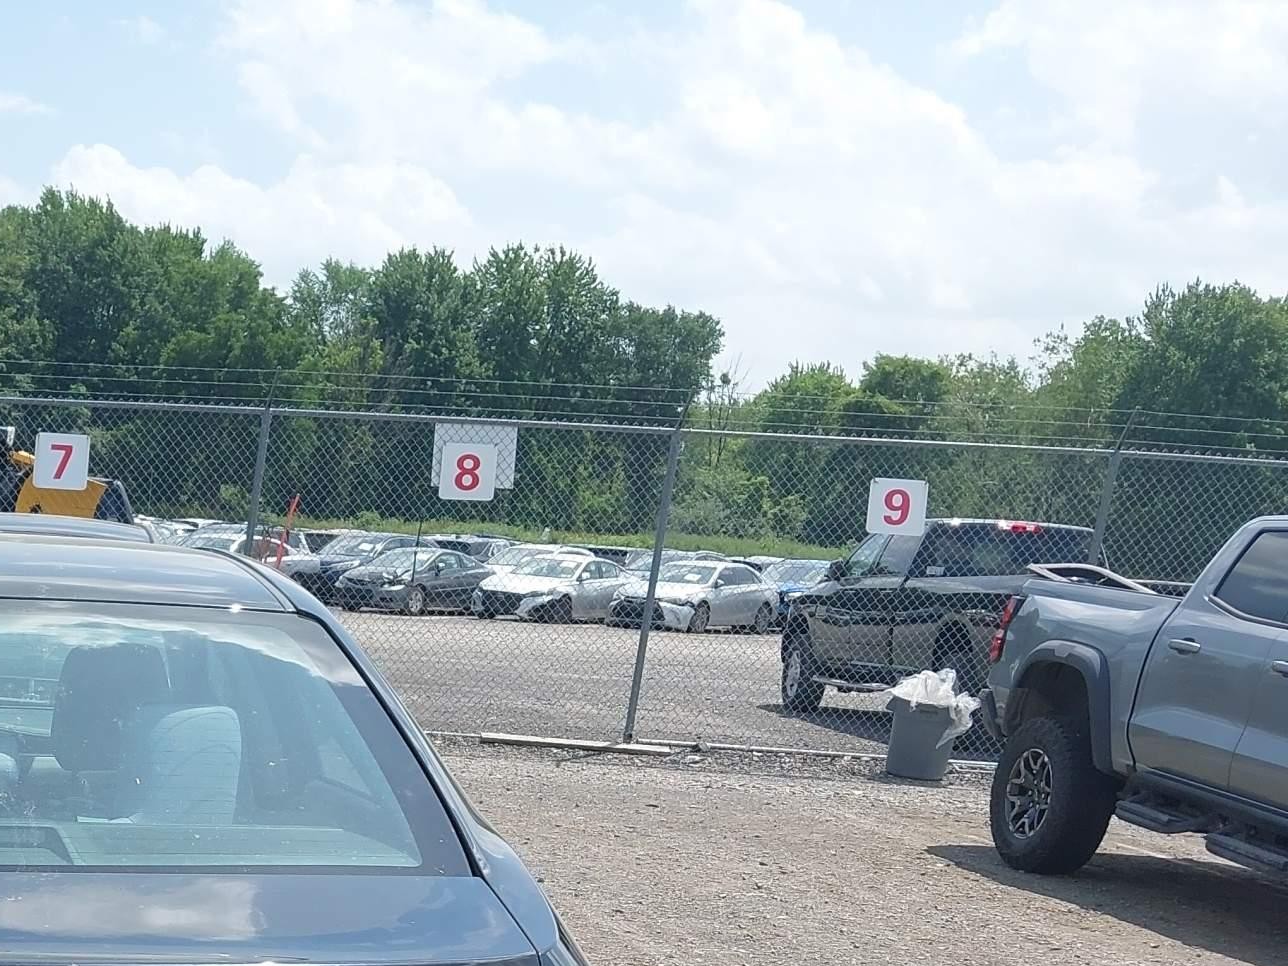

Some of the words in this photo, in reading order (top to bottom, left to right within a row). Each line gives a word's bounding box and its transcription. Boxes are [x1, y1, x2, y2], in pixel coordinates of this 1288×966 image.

[51, 444, 73, 480] 7
[454, 453, 481, 491] 8
[883, 488, 911, 526] 9
